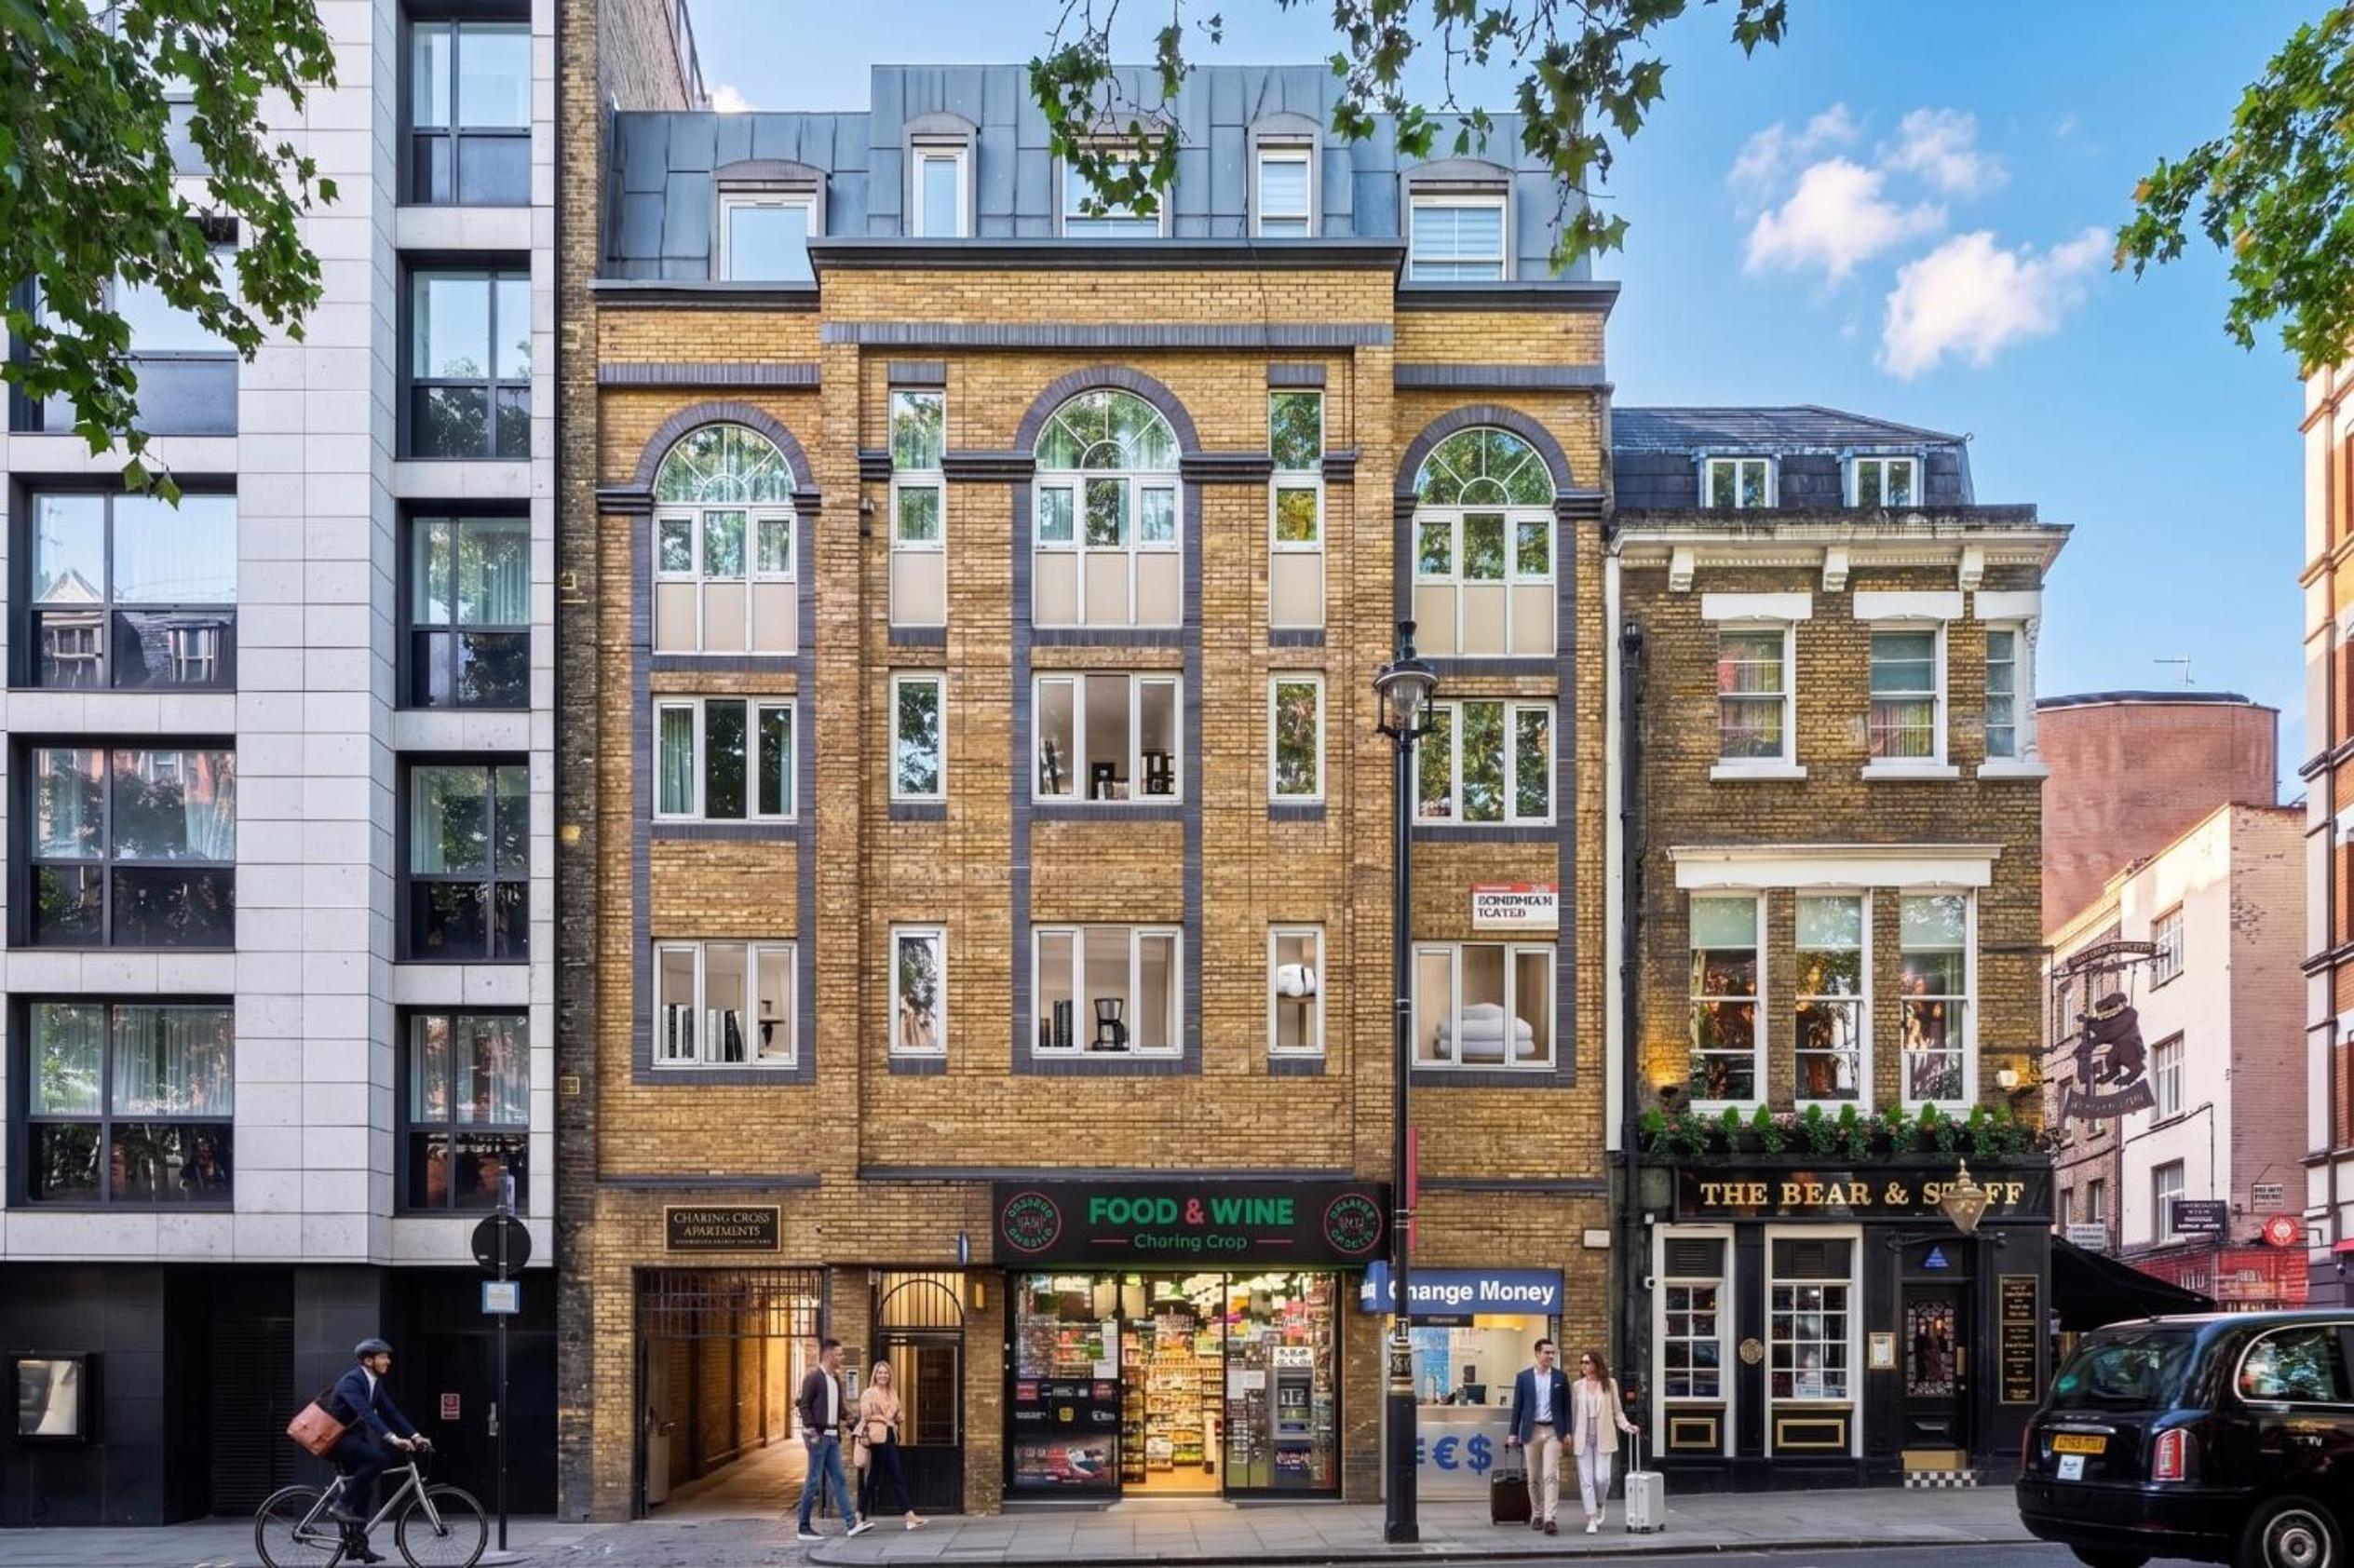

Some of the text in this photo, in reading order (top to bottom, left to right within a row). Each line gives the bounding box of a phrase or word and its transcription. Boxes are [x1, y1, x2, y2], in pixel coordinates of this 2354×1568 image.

[1700, 1182, 2025, 1206] THE BEAR & STFF
[673, 1212, 770, 1223] CHARING CROSS
[1089, 1196, 1294, 1225] FOOD & WINE
[683, 1225, 761, 1237] APARTMENTS
[1206, 1234, 1249, 1252] Crop
[1479, 1279, 1555, 1306] Money
